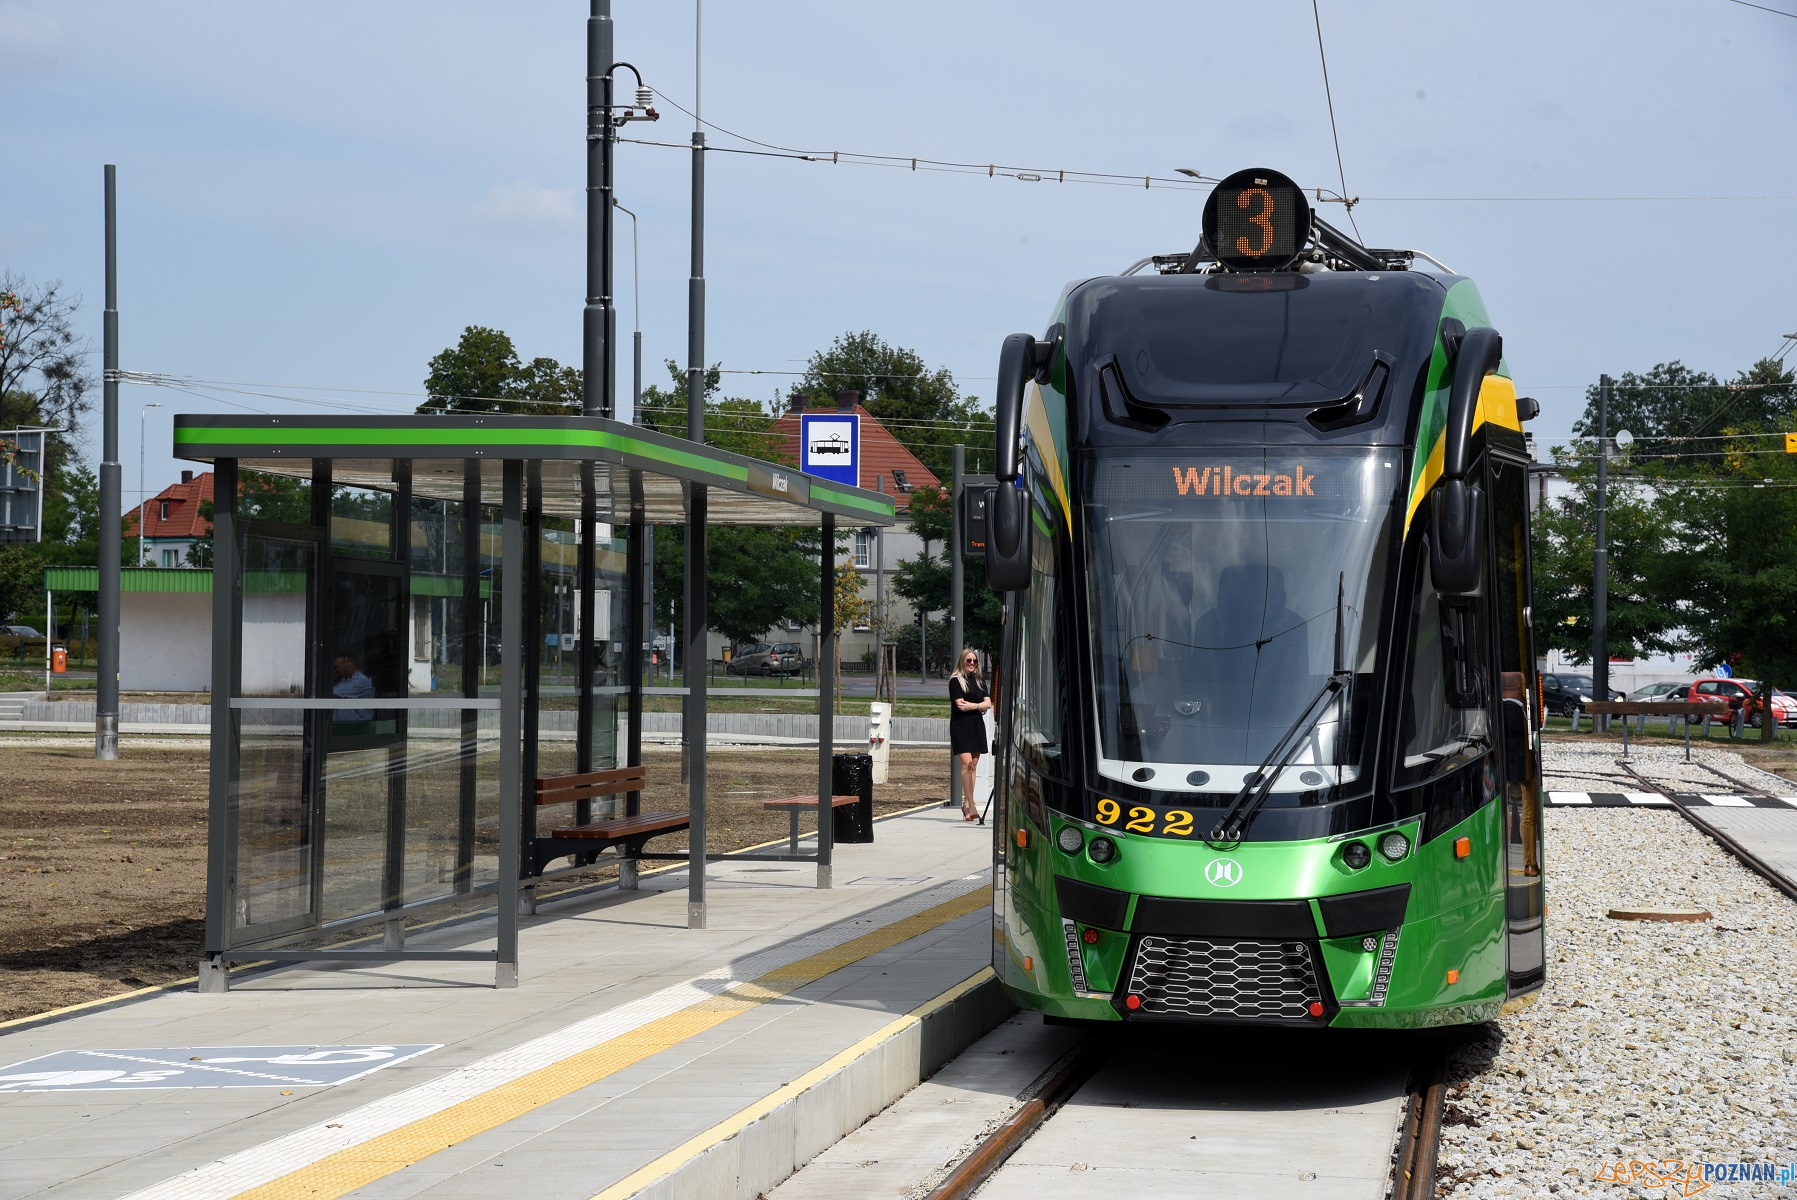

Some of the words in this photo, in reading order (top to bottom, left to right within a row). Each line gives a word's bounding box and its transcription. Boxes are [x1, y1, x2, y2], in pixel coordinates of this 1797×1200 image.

[1236, 188, 1274, 256] 3
[1172, 465, 1315, 496] Wilczak
[1095, 798, 1194, 836] 922
